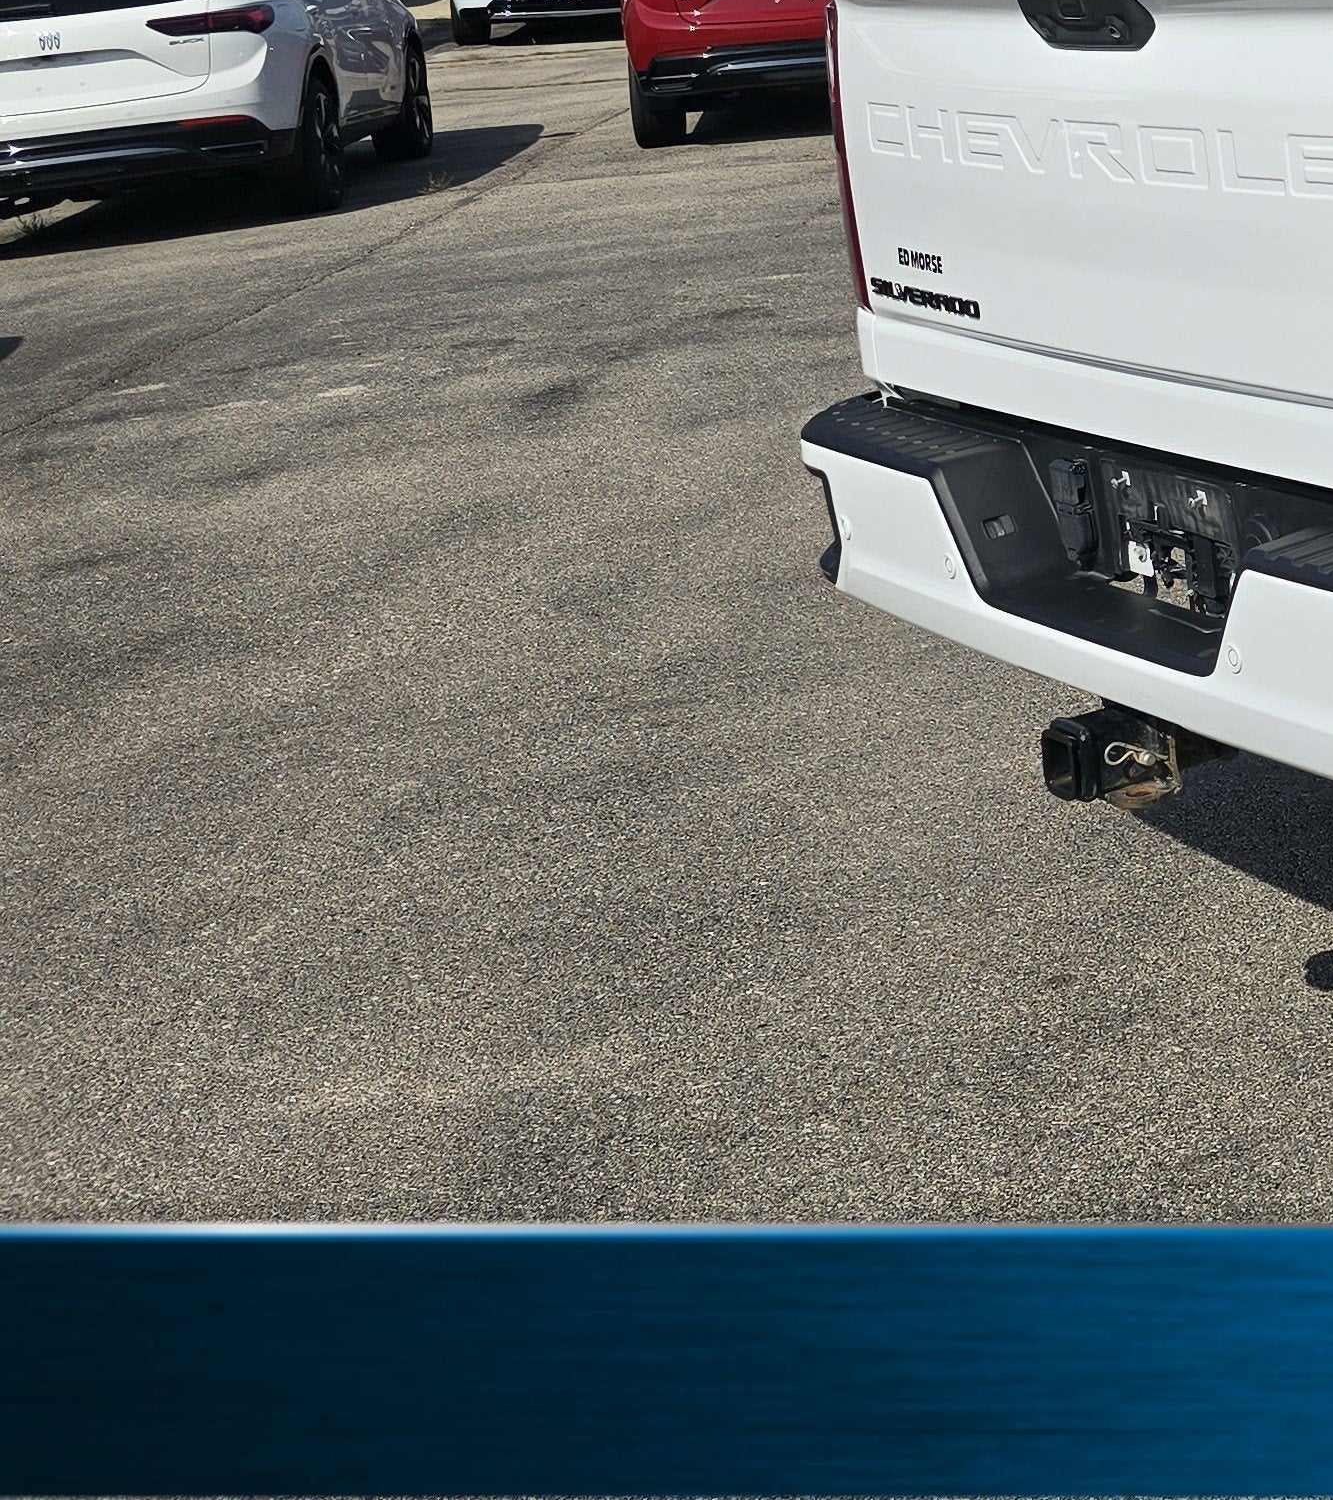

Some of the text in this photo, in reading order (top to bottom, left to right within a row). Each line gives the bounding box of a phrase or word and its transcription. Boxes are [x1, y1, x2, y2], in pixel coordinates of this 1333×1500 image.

[897, 247, 943, 274] ED MORSE
[870, 276, 981, 320] SILVERADO
